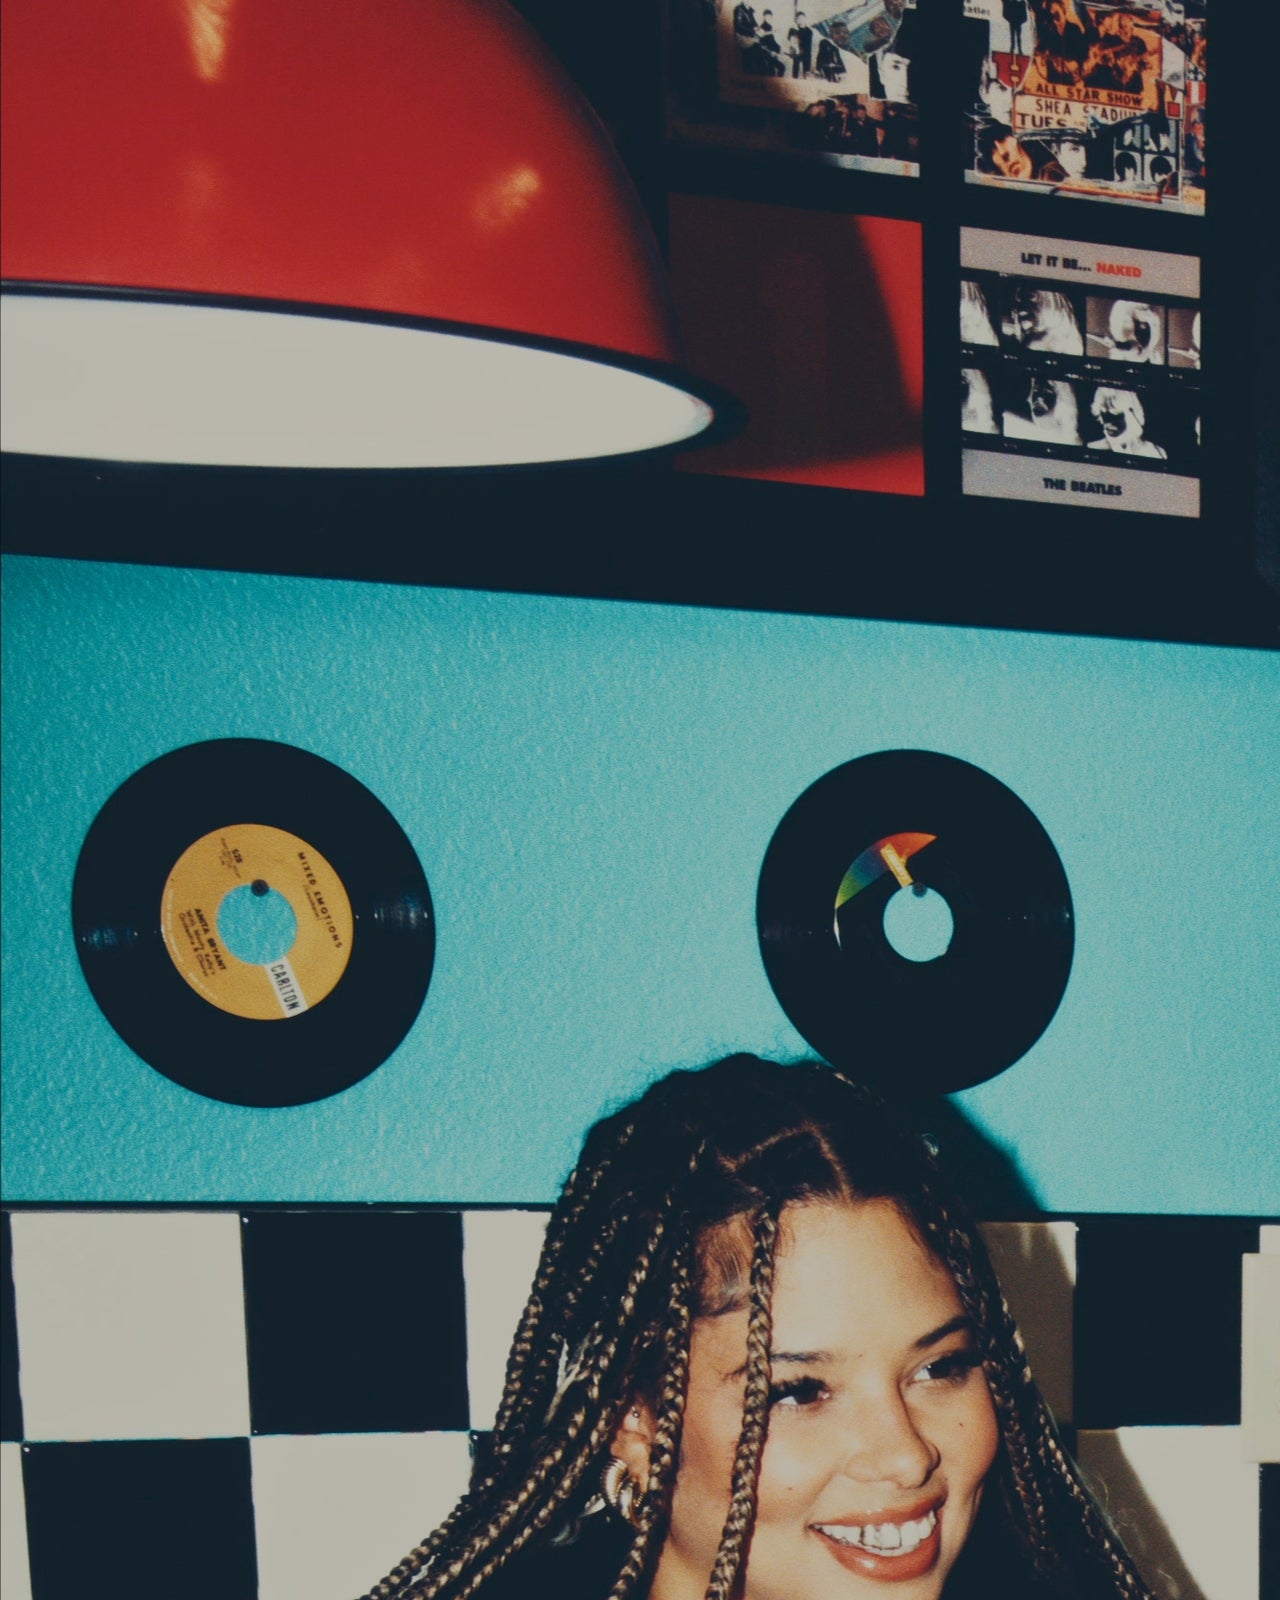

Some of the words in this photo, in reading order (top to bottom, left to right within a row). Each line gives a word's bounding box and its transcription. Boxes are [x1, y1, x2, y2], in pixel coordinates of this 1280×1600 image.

[1035, 99, 1072, 116] SHEA
[1036, 83, 1058, 95] ALL
[1067, 87, 1099, 100] STAR
[1107, 92, 1144, 106] SHOW
[1021, 252, 1042, 265] LET
[1046, 256, 1059, 268] IT
[1096, 262, 1142, 278] NAKED
[1043, 477, 1066, 491] THE
[1071, 480, 1122, 496] BEATLES
[298, 853, 317, 886] MIXED
[314, 890, 342, 948] EMOTIONS
[195, 908, 210, 933] ANITA
[207, 938, 226, 970] BRYANT
[271, 963, 300, 1011] CARLTON
